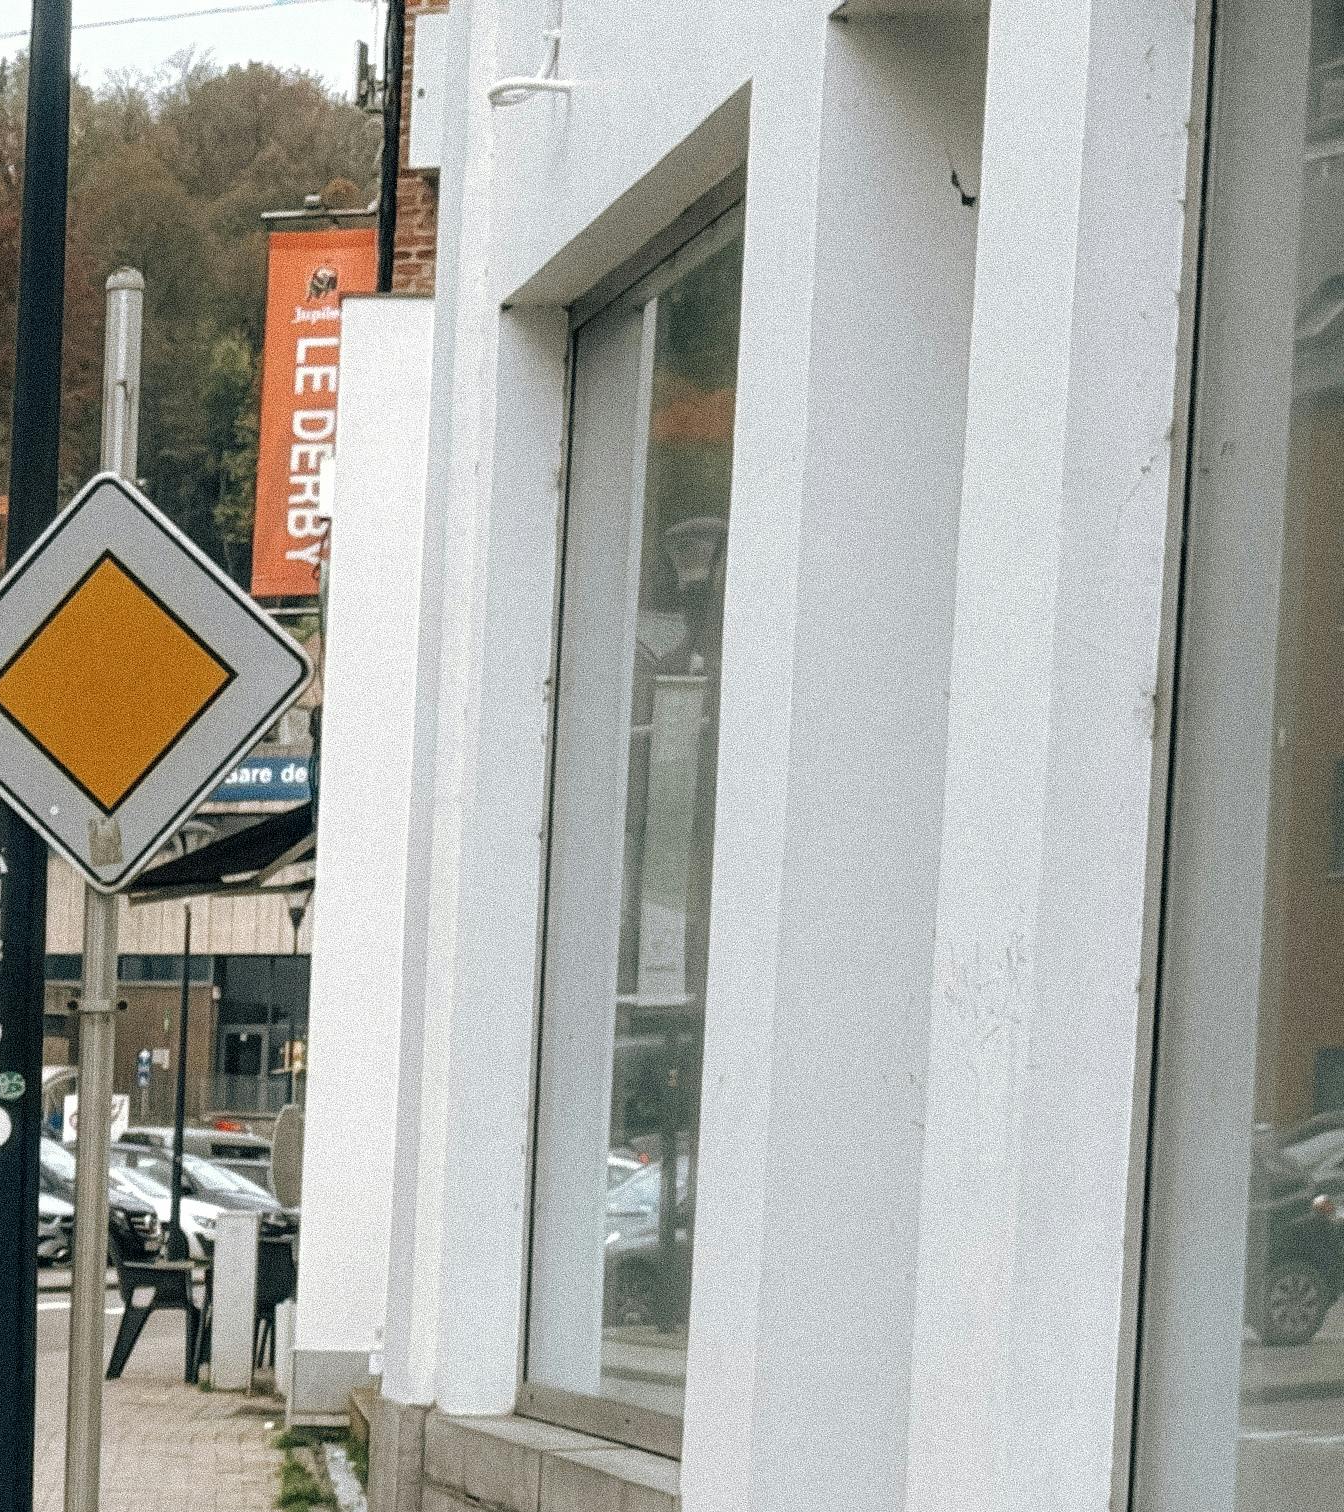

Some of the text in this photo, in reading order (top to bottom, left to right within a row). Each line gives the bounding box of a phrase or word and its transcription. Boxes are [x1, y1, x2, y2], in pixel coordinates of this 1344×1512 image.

[290, 304, 340, 325] Jupile
[285, 335, 340, 567] LE DERBY
[280, 763, 309, 783] de
